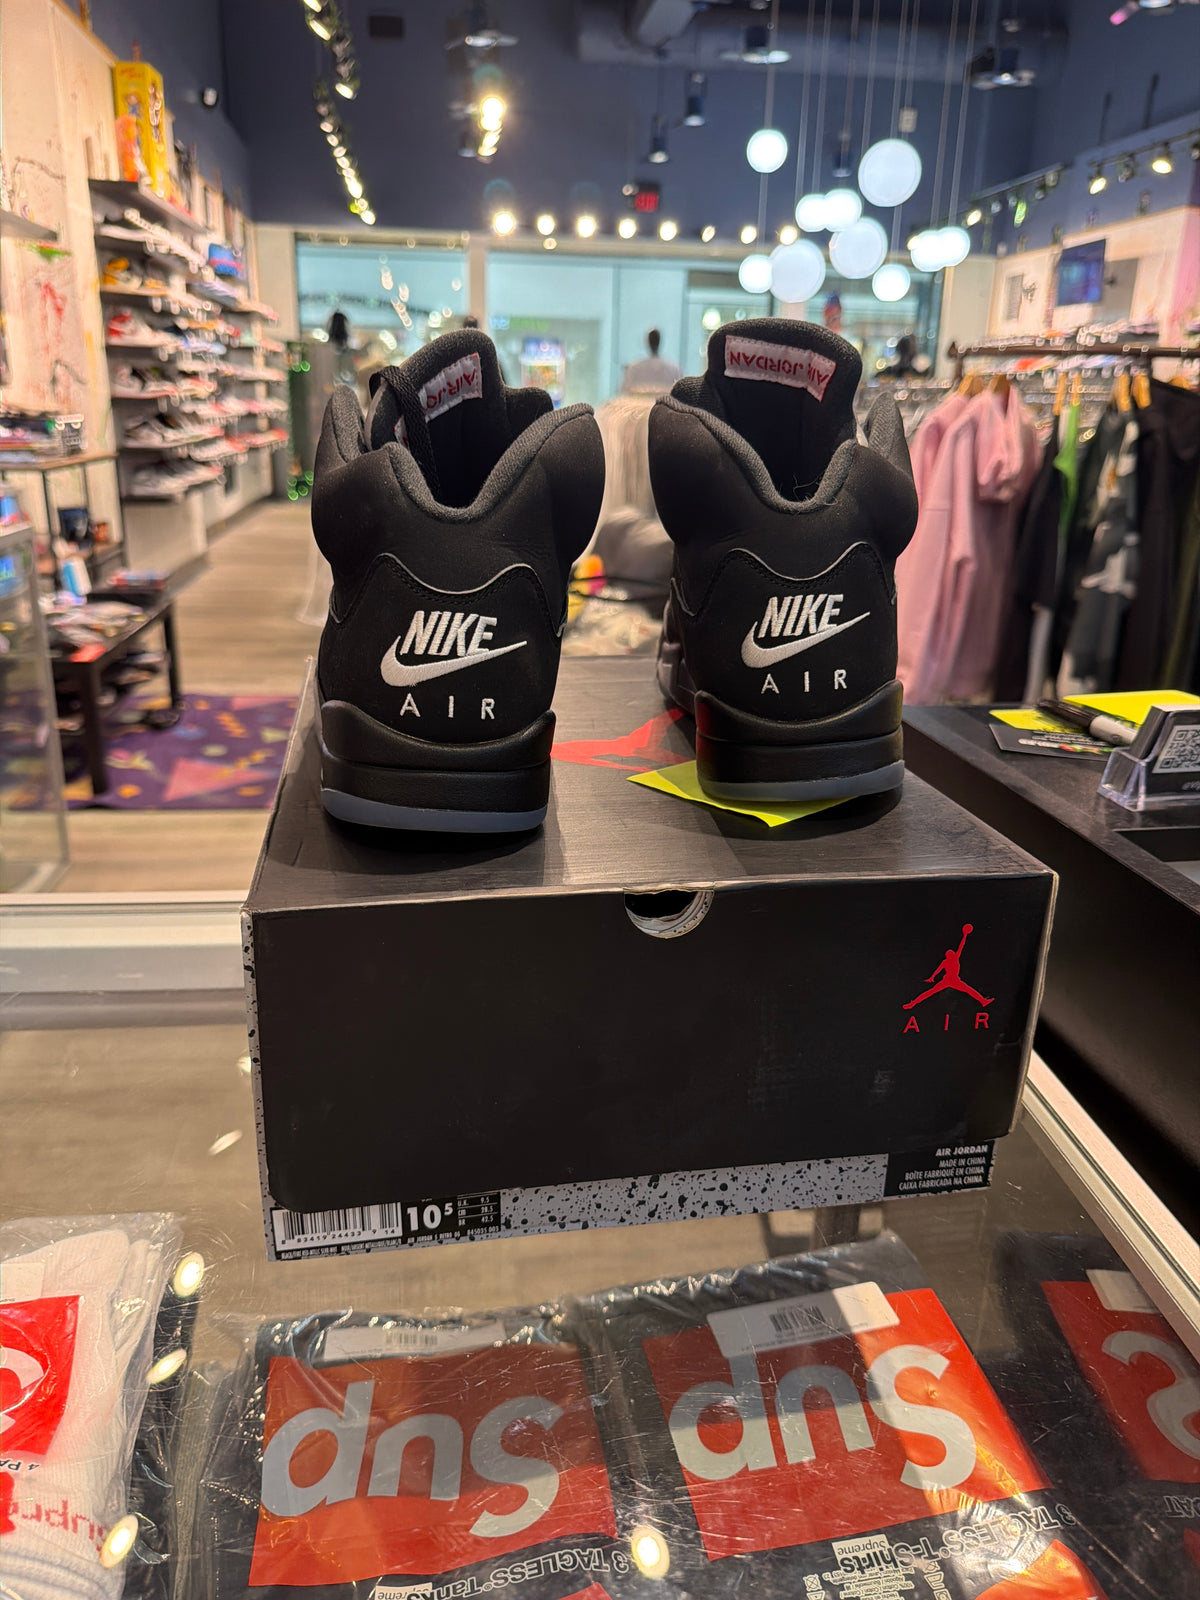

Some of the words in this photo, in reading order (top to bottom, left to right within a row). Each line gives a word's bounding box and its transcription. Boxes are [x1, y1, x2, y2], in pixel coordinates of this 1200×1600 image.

[730, 351, 804, 376] JORDAN
[758, 593, 844, 638] NIKE
[400, 610, 498, 657] NIKE
[760, 669, 847, 694] AIR
[400, 693, 495, 720] AIR
[902, 1012, 989, 1033] AIR
[935, 1148, 951, 1157] AIR
[953, 1145, 988, 1155] JORDAN
[939, 1159, 957, 1168] MADE
[958, 1158, 966, 1166] IN
[966, 1156, 986, 1165] CHINA
[955, 1168, 964, 1176] EN
[964, 1166, 985, 1175] CHINA
[899, 1181, 917, 1191] CAIXA
[918, 1179, 952, 1189] FABRICADA
[953, 1177, 962, 1185] NA
[963, 1175, 983, 1184] CHINA
[481, 1215, 494, 1223] 42.5
[28, 1463, 40, 1471] 4
[1055, 1503, 1077, 1526] 3
[837, 1539, 886, 1557] Supreme
[611, 1550, 629, 1574] 3
